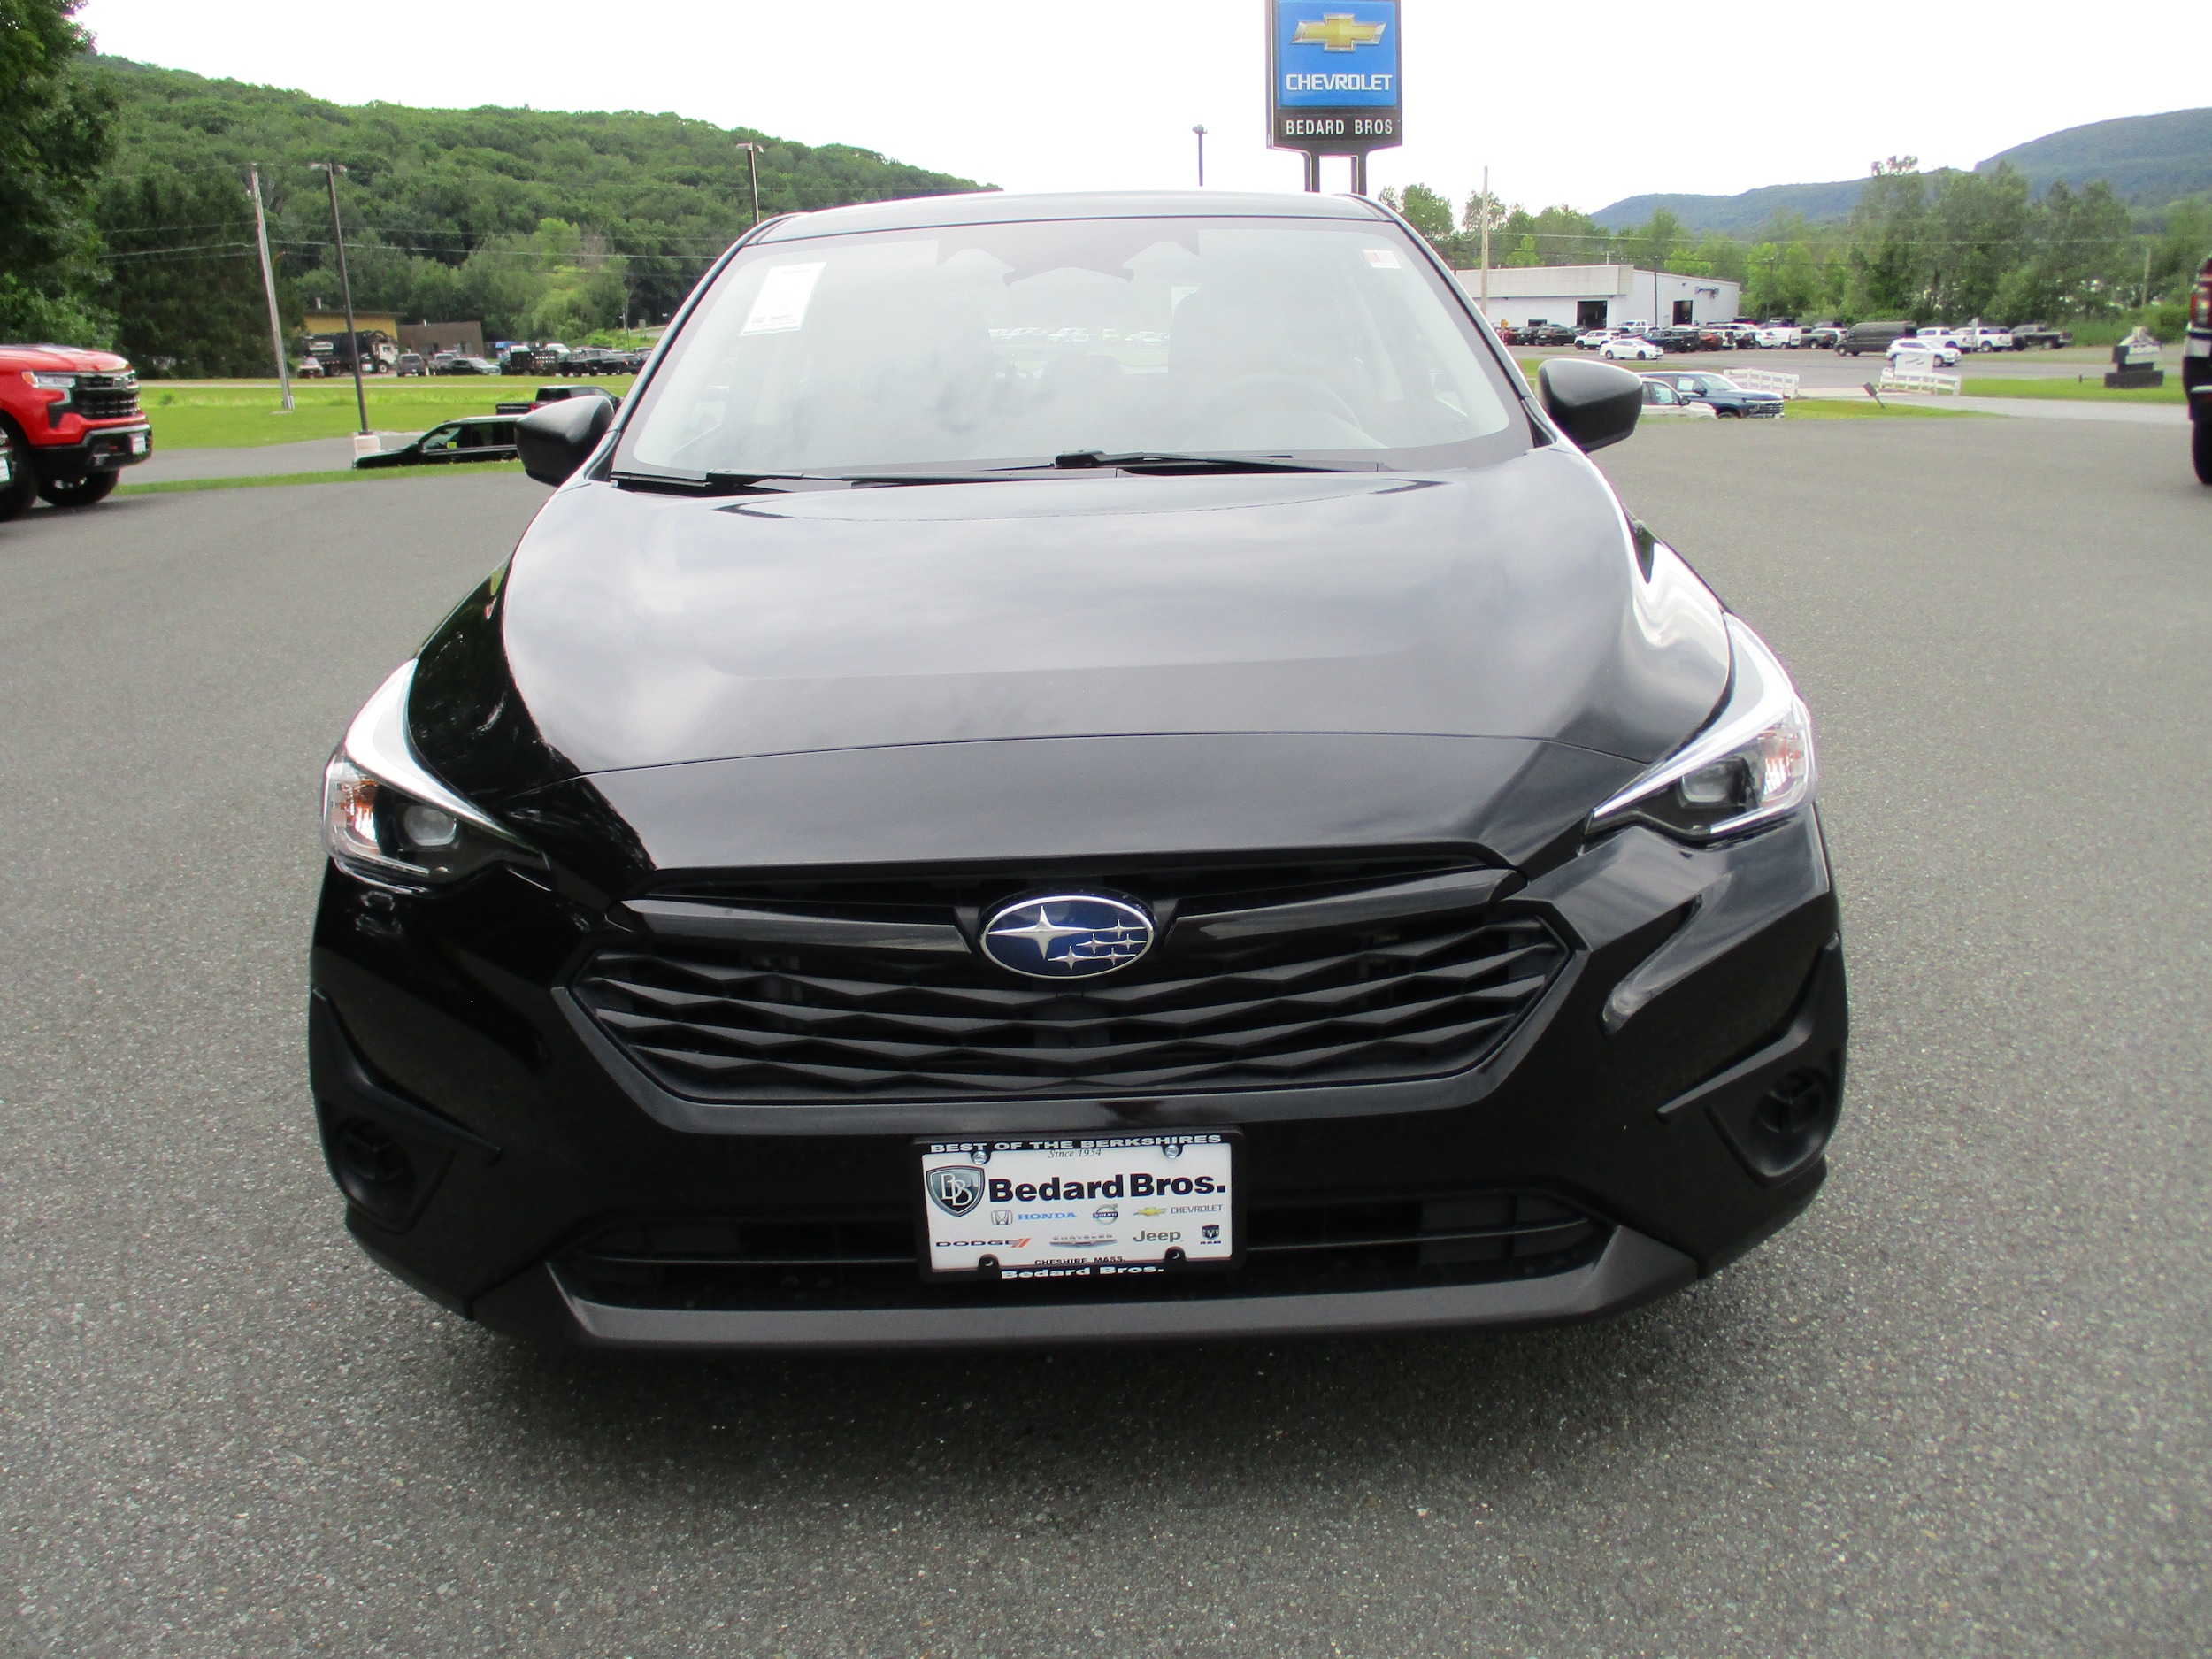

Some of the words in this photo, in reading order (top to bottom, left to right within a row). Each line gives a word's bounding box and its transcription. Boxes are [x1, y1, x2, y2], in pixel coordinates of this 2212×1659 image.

[1286, 73, 1393, 91] CHEVROLET
[1286, 119, 1345, 135] BEDARD
[1354, 119, 1393, 135] BROS
[931, 1143, 987, 1153] BEST
[994, 1141, 1023, 1150] OF
[1029, 1141, 1073, 1149] THE
[1080, 1134, 1222, 1148] BERKSHIRES
[1048, 1149, 1074, 1159] Since
[1078, 1148, 1102, 1157] 1954
[988, 1174, 1125, 1202] Bedard
[1130, 1173, 1226, 1197] Bros.
[1018, 1211, 1078, 1221] HONDA
[1171, 1204, 1223, 1215] CHEVROLET
[1133, 1230, 1181, 1243] Jeep
[1034, 1257, 1087, 1266] CHESHIRE
[1001, 1266, 1091, 1279] Bedard
[1099, 1265, 1164, 1275] Bros.
